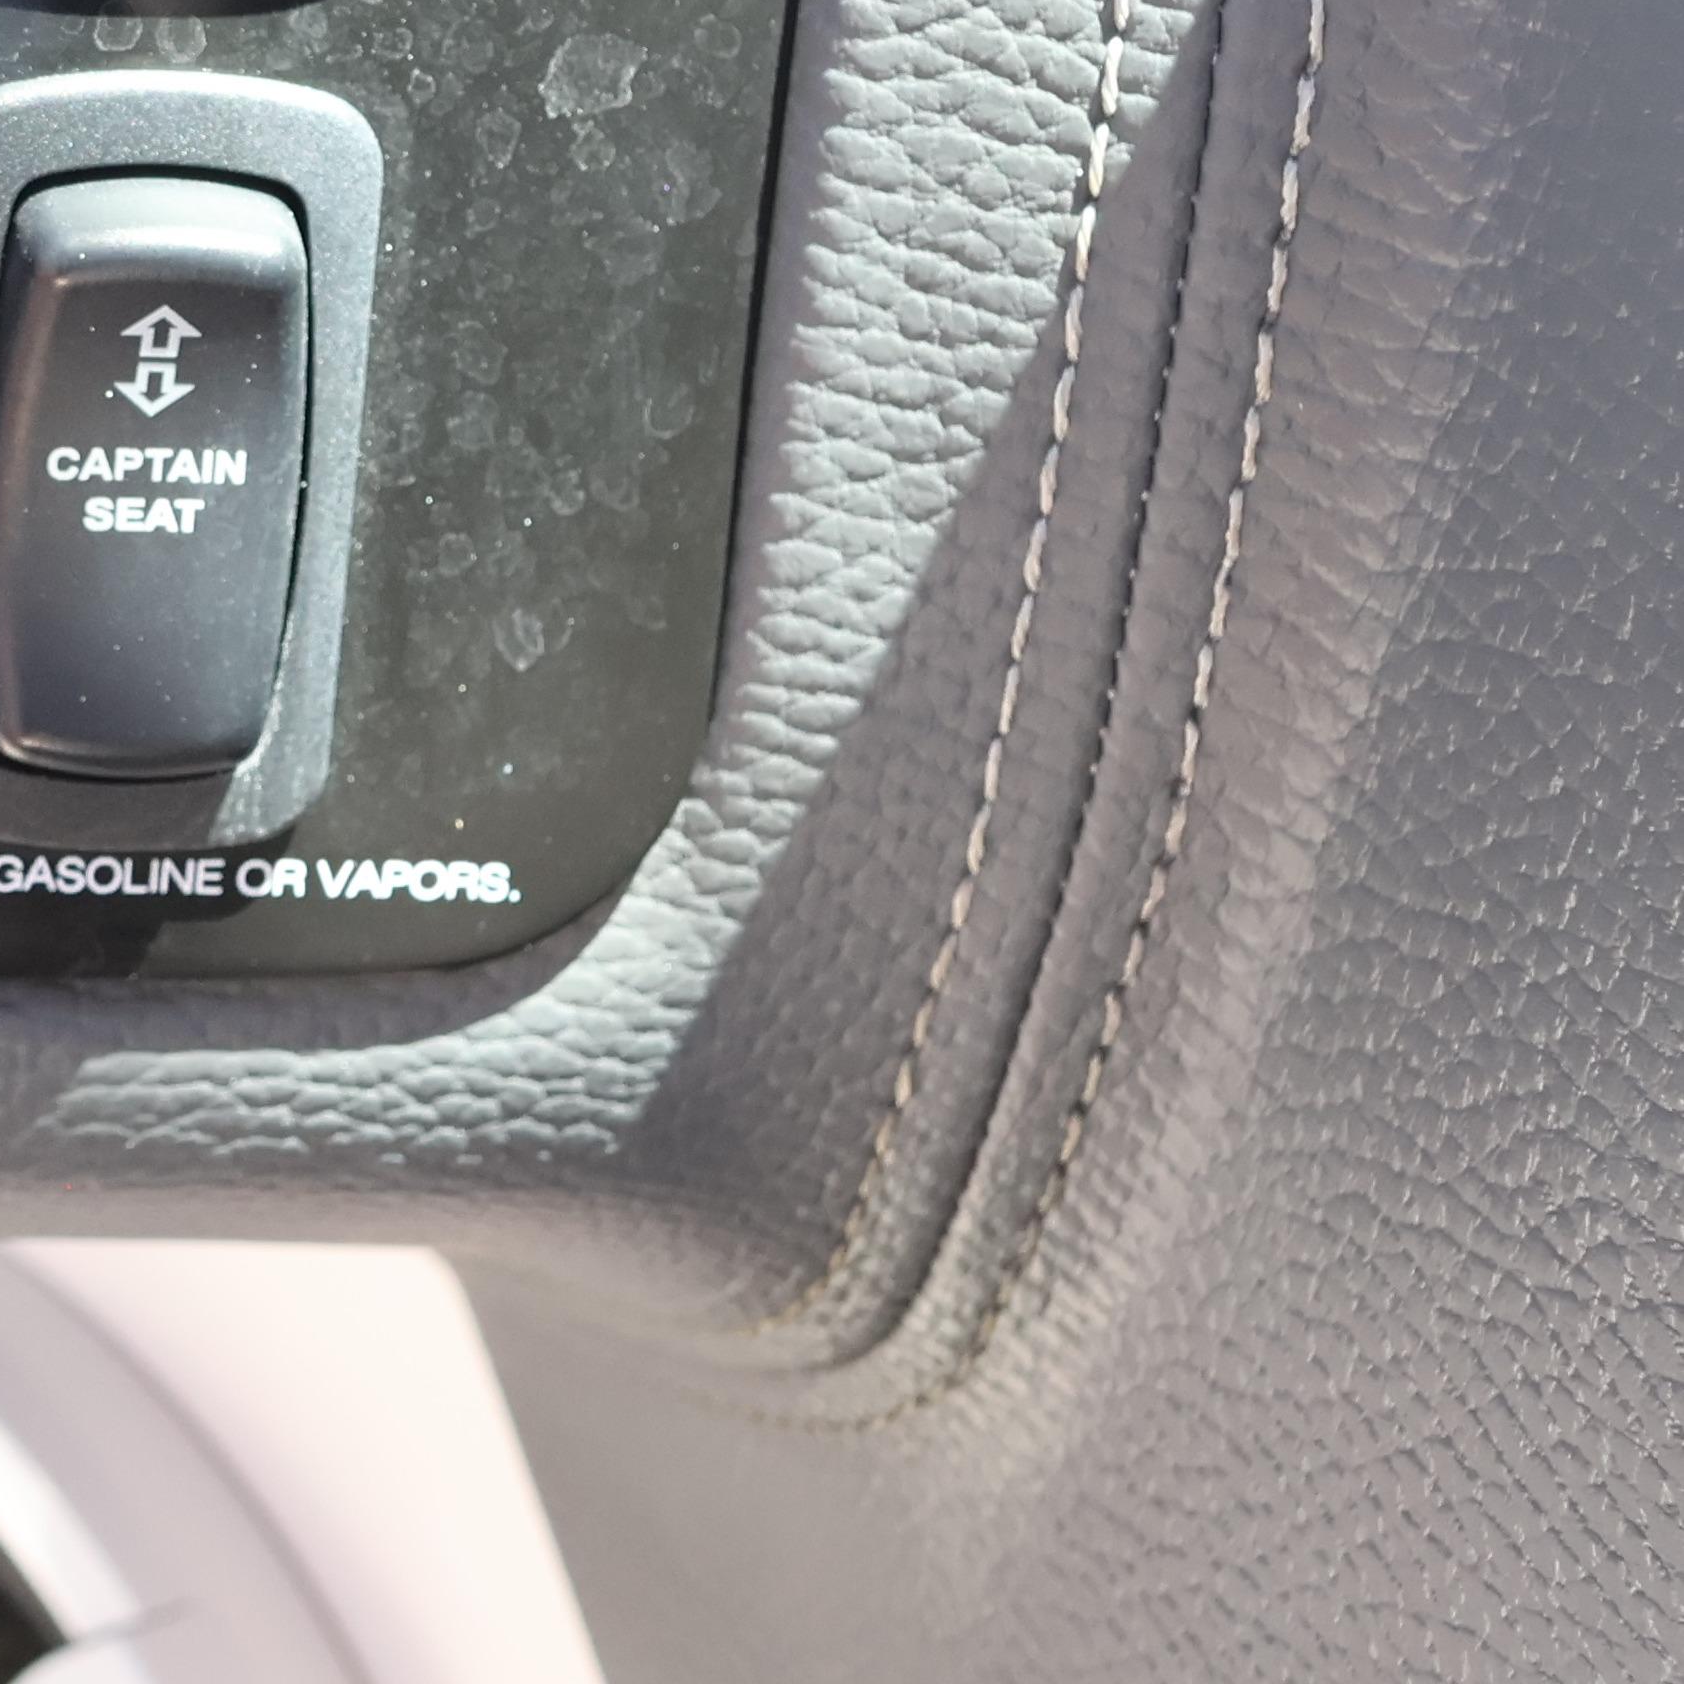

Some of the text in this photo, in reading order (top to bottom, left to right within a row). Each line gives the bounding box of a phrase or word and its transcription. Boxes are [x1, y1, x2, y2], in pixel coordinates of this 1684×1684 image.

[46, 446, 248, 485] CAPTAIN
[82, 497, 205, 534] SEAT
[235, 858, 307, 898] OR
[315, 859, 520, 903] VAPORS.
